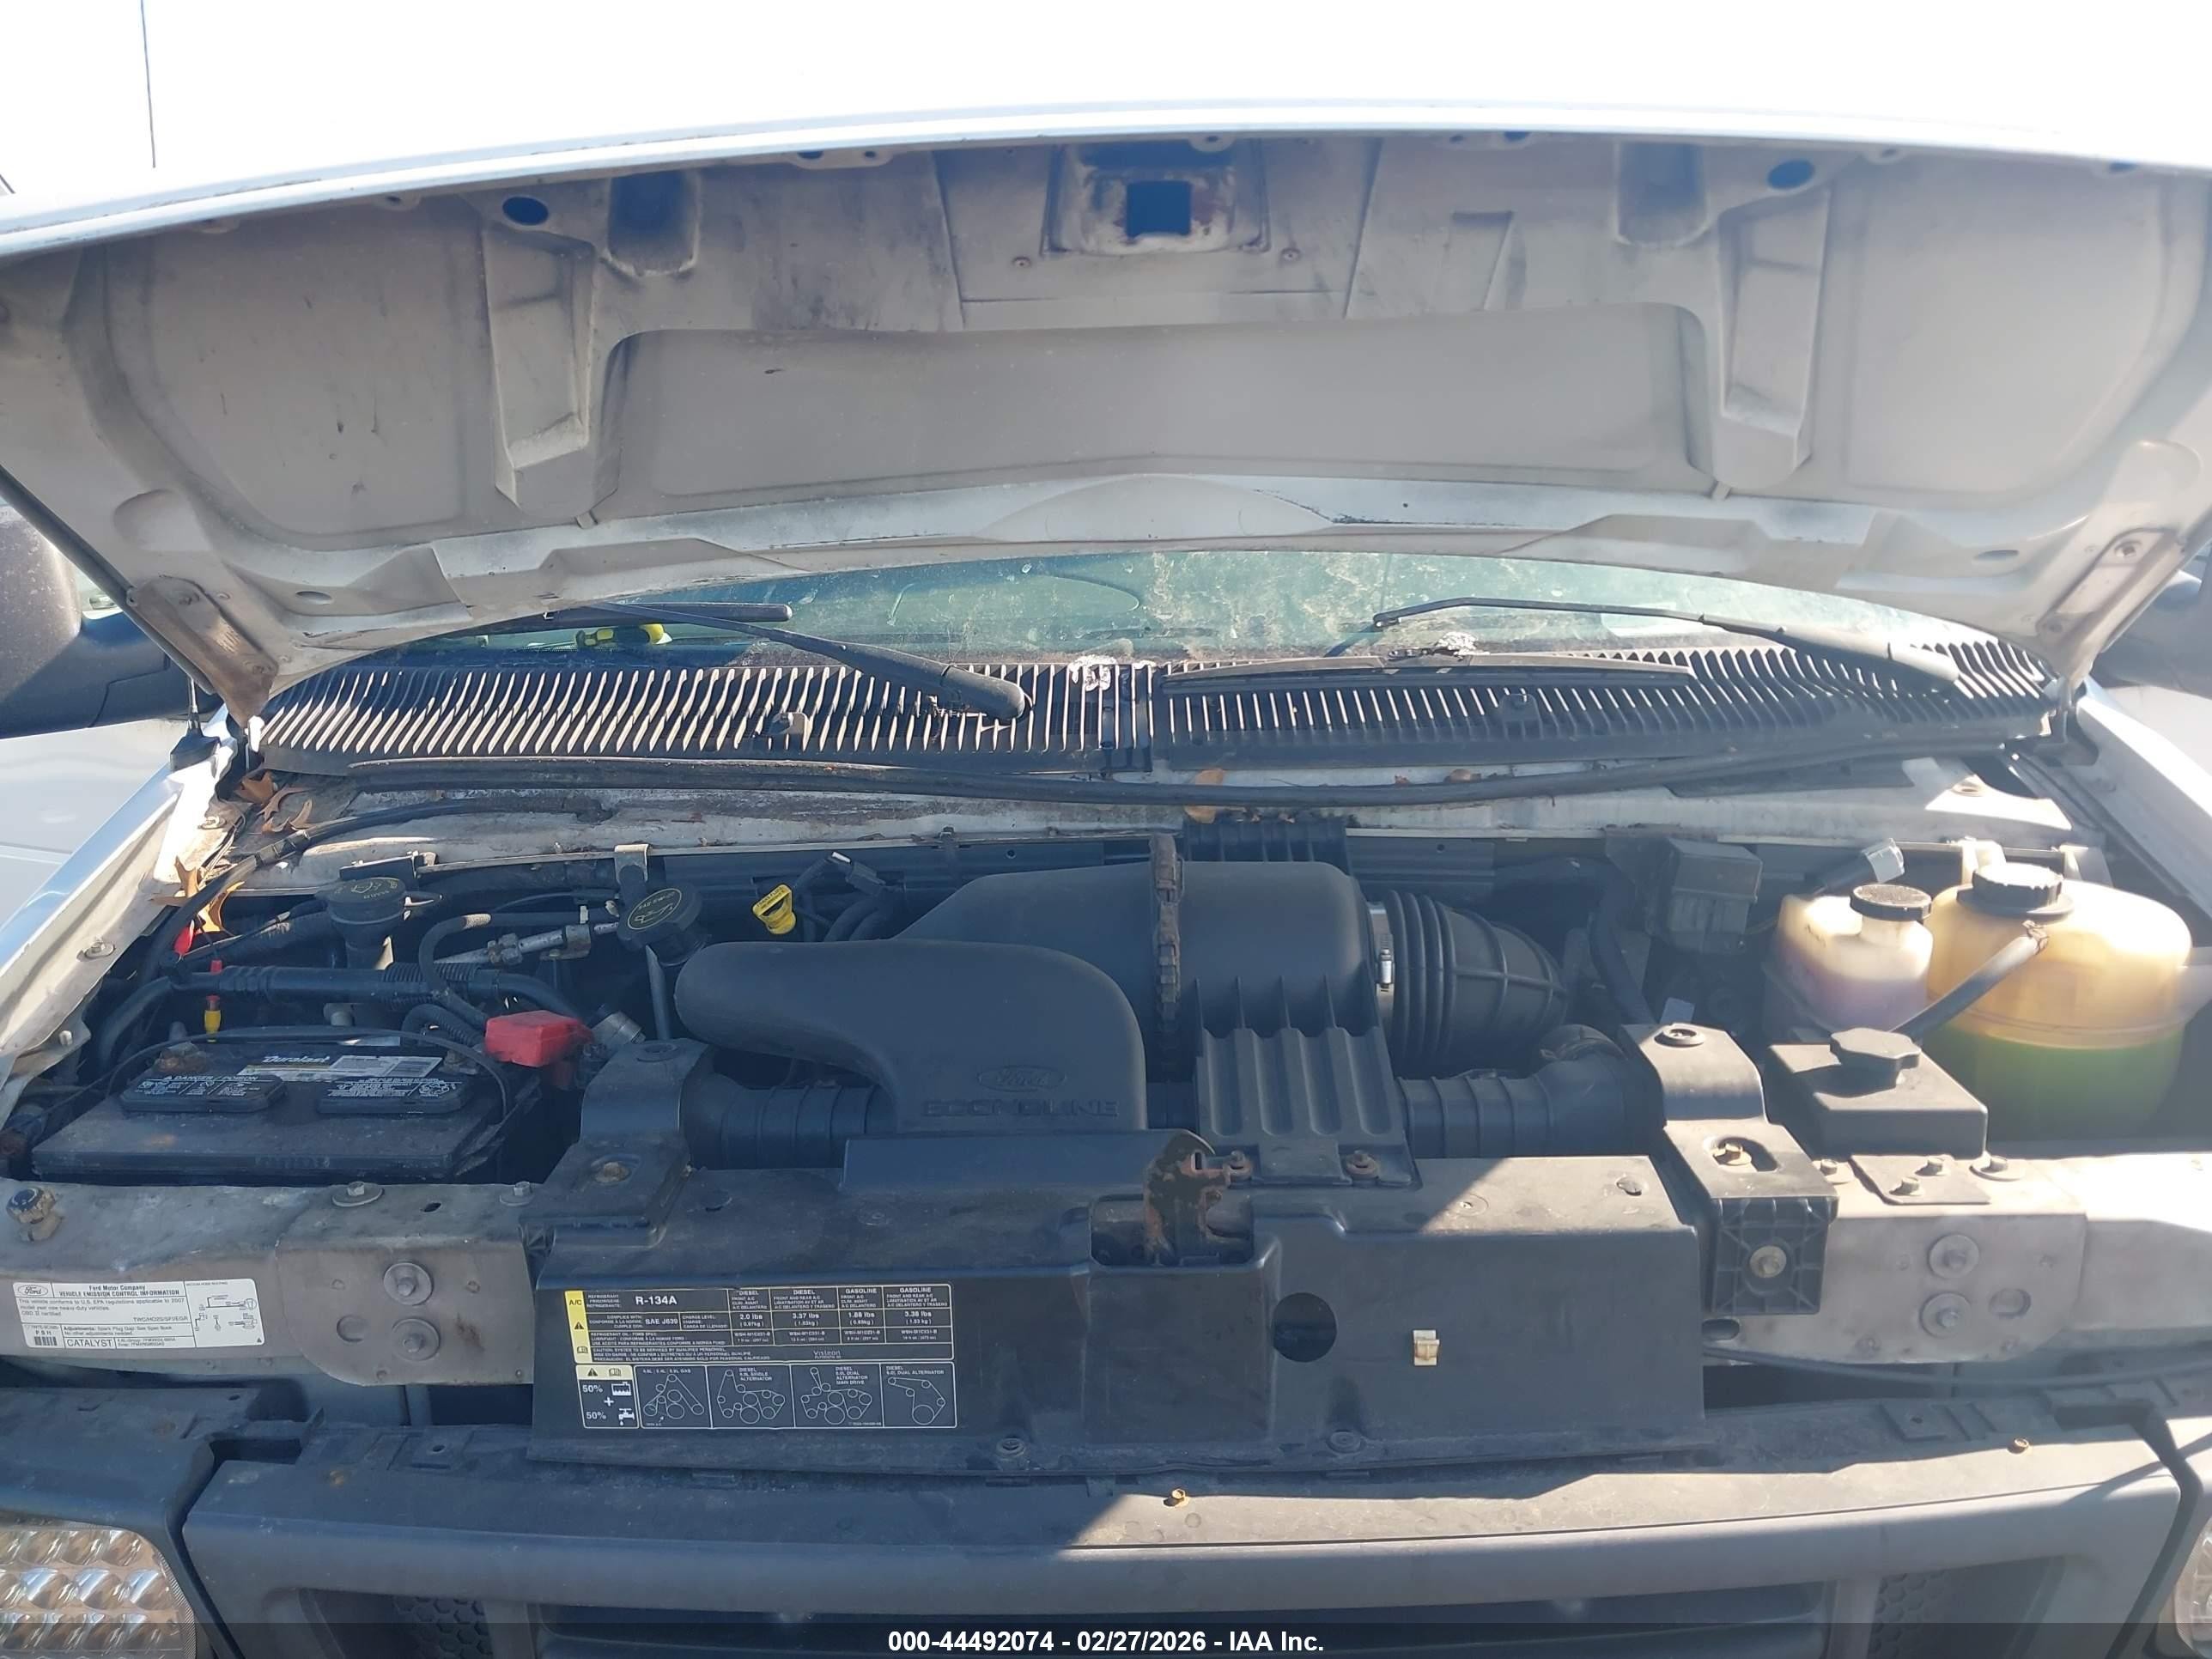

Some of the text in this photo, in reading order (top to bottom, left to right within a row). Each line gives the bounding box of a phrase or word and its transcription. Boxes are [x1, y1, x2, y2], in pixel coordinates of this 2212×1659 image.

[25, 1285, 42, 1296] Ford
[635, 1295, 678, 1306] R-134A
[67, 1339, 112, 1347] CATALYST
[582, 1384, 604, 1393] 50%
[586, 1411, 606, 1419] 50%
